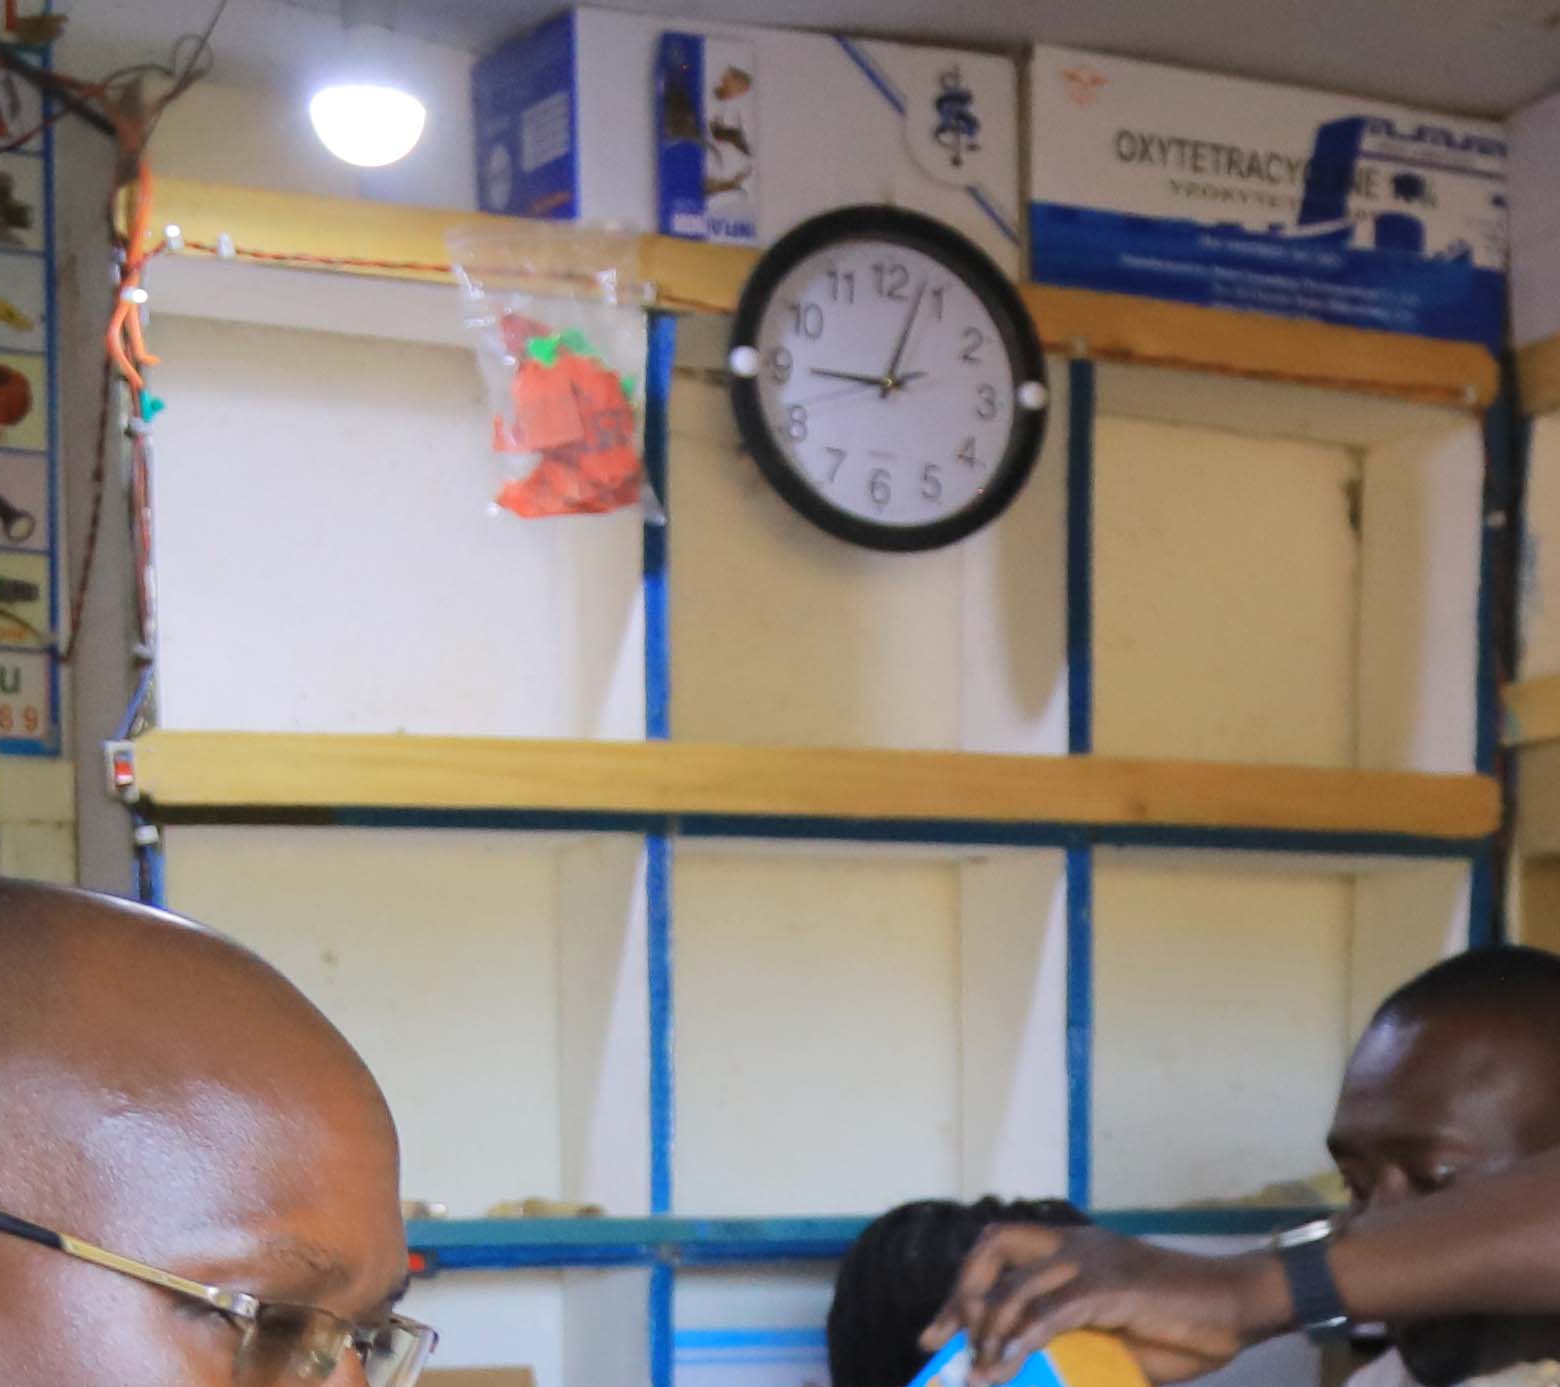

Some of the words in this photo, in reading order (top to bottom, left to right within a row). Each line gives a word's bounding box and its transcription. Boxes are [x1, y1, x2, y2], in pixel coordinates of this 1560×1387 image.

[825, 268, 855, 304] 11
[871, 263, 909, 302] 12
[788, 302, 824, 340] 10
[960, 326, 984, 364] 2
